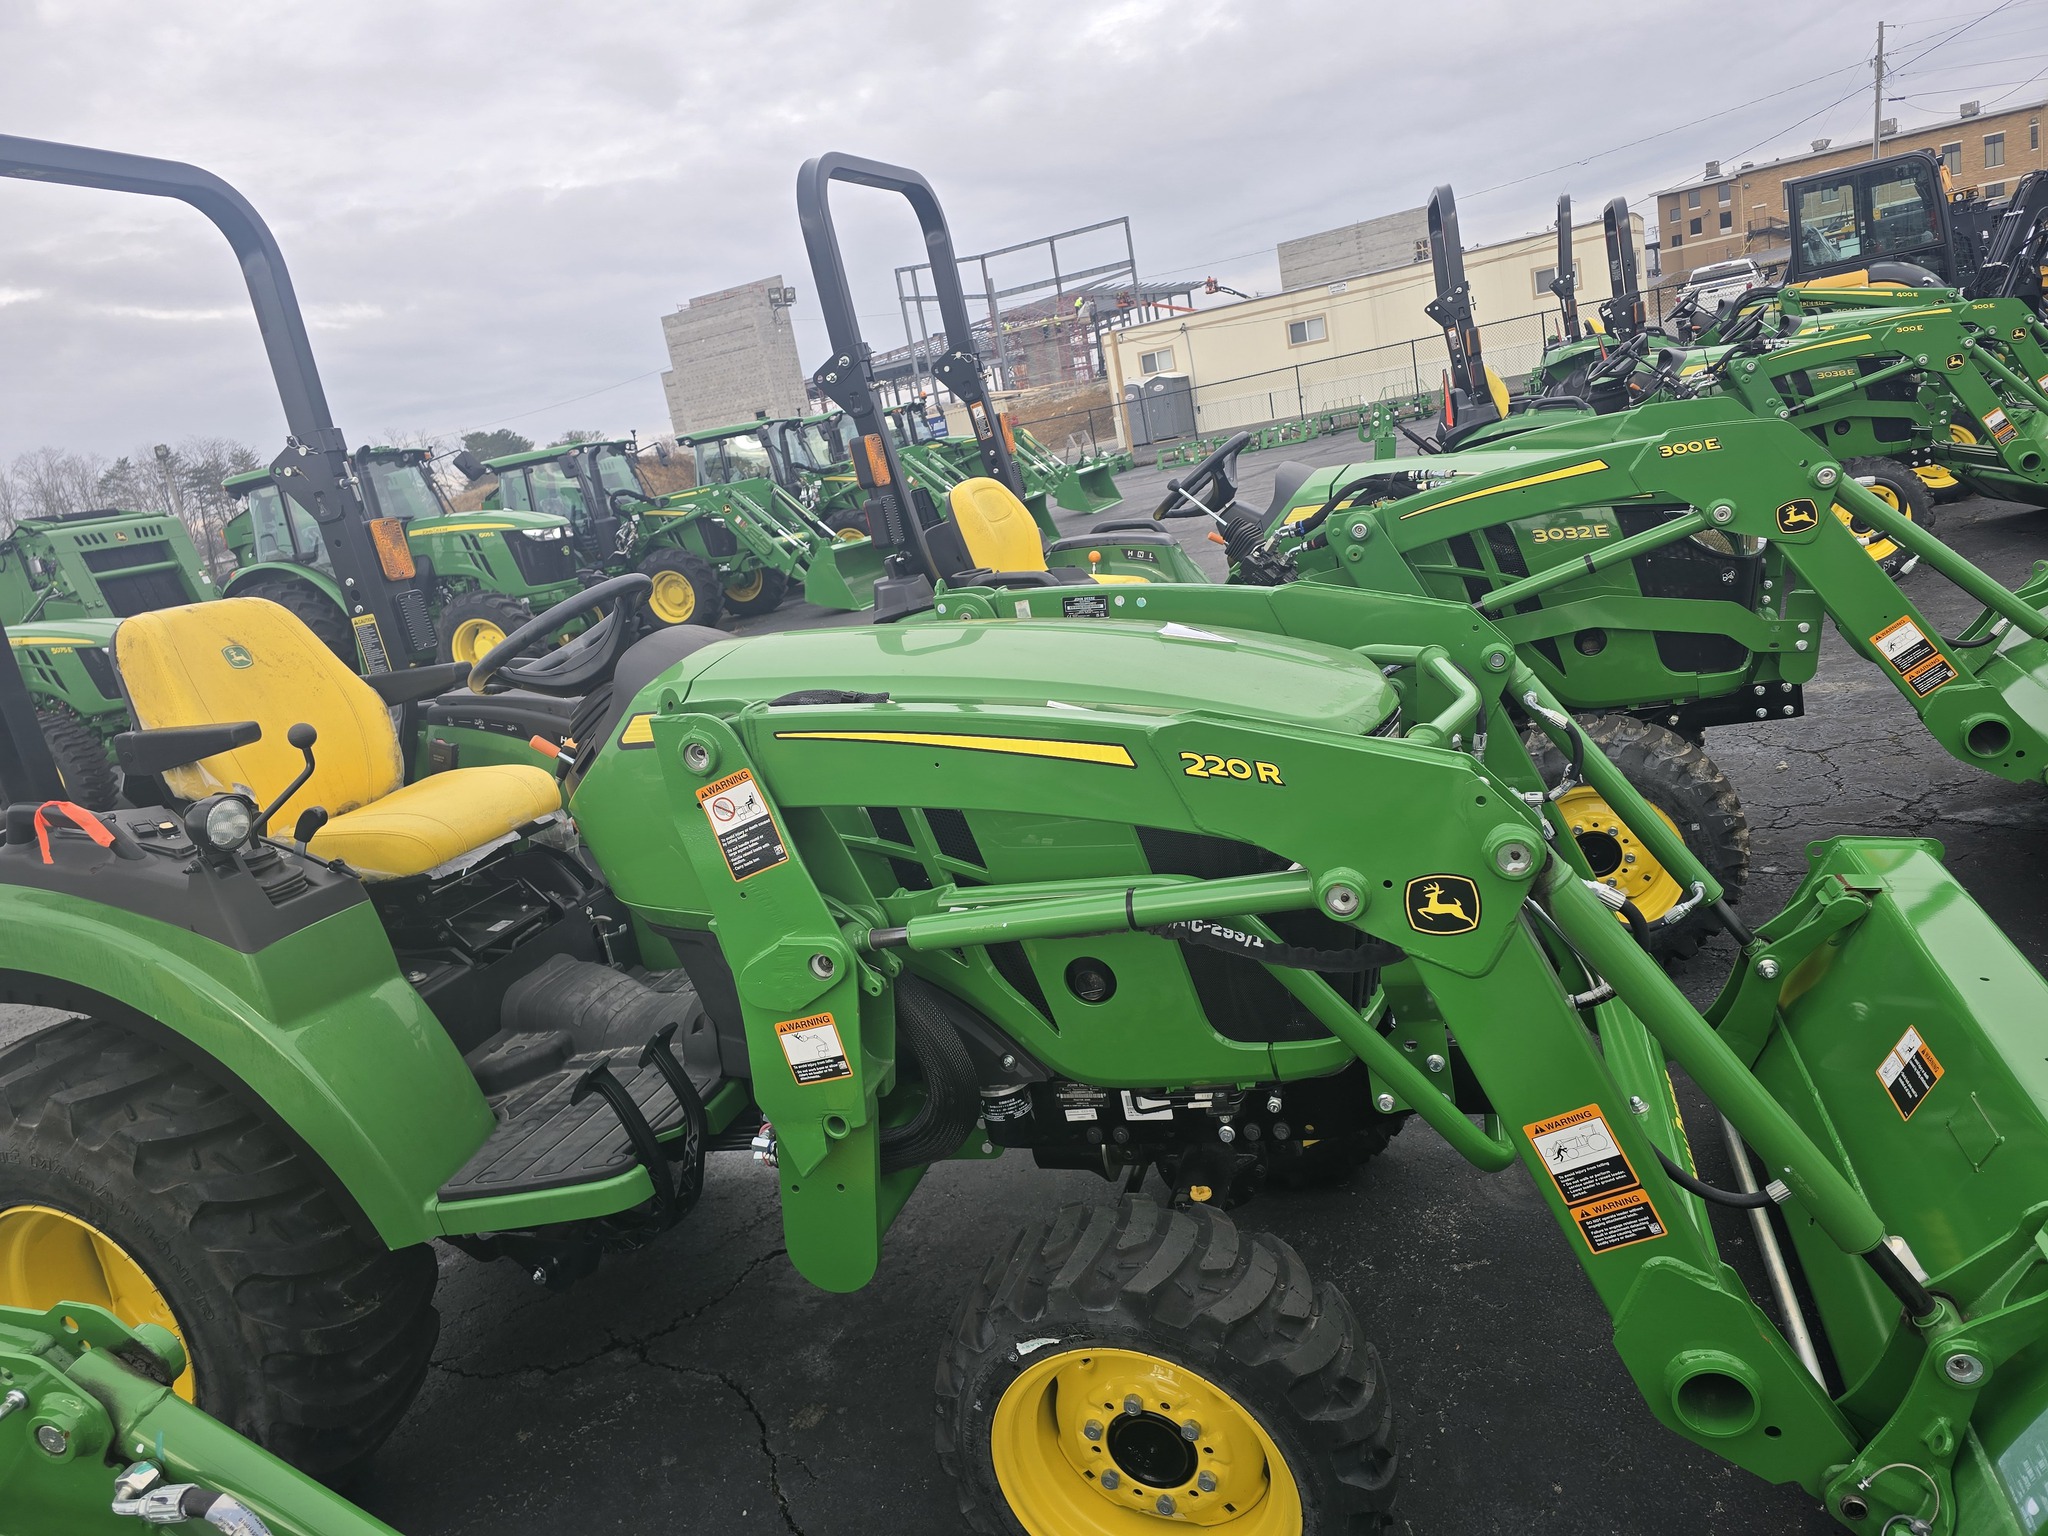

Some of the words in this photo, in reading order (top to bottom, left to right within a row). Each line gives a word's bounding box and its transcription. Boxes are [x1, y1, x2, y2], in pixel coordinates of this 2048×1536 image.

[1896, 324, 1924, 334] 300E
[1816, 368, 1855, 380] 3038E
[1658, 437, 1723, 459] 300E
[1532, 524, 1610, 543] 3032E
[1880, 619, 1906, 637] WARNING
[1915, 657, 1940, 675] WARNING
[1178, 751, 1287, 787] 220R
[706, 770, 749, 796] WARNING
[786, 1015, 830, 1031] WARNING
[1544, 1110, 1592, 1130] WARNING
[1592, 1195, 1641, 1214] WARNING
